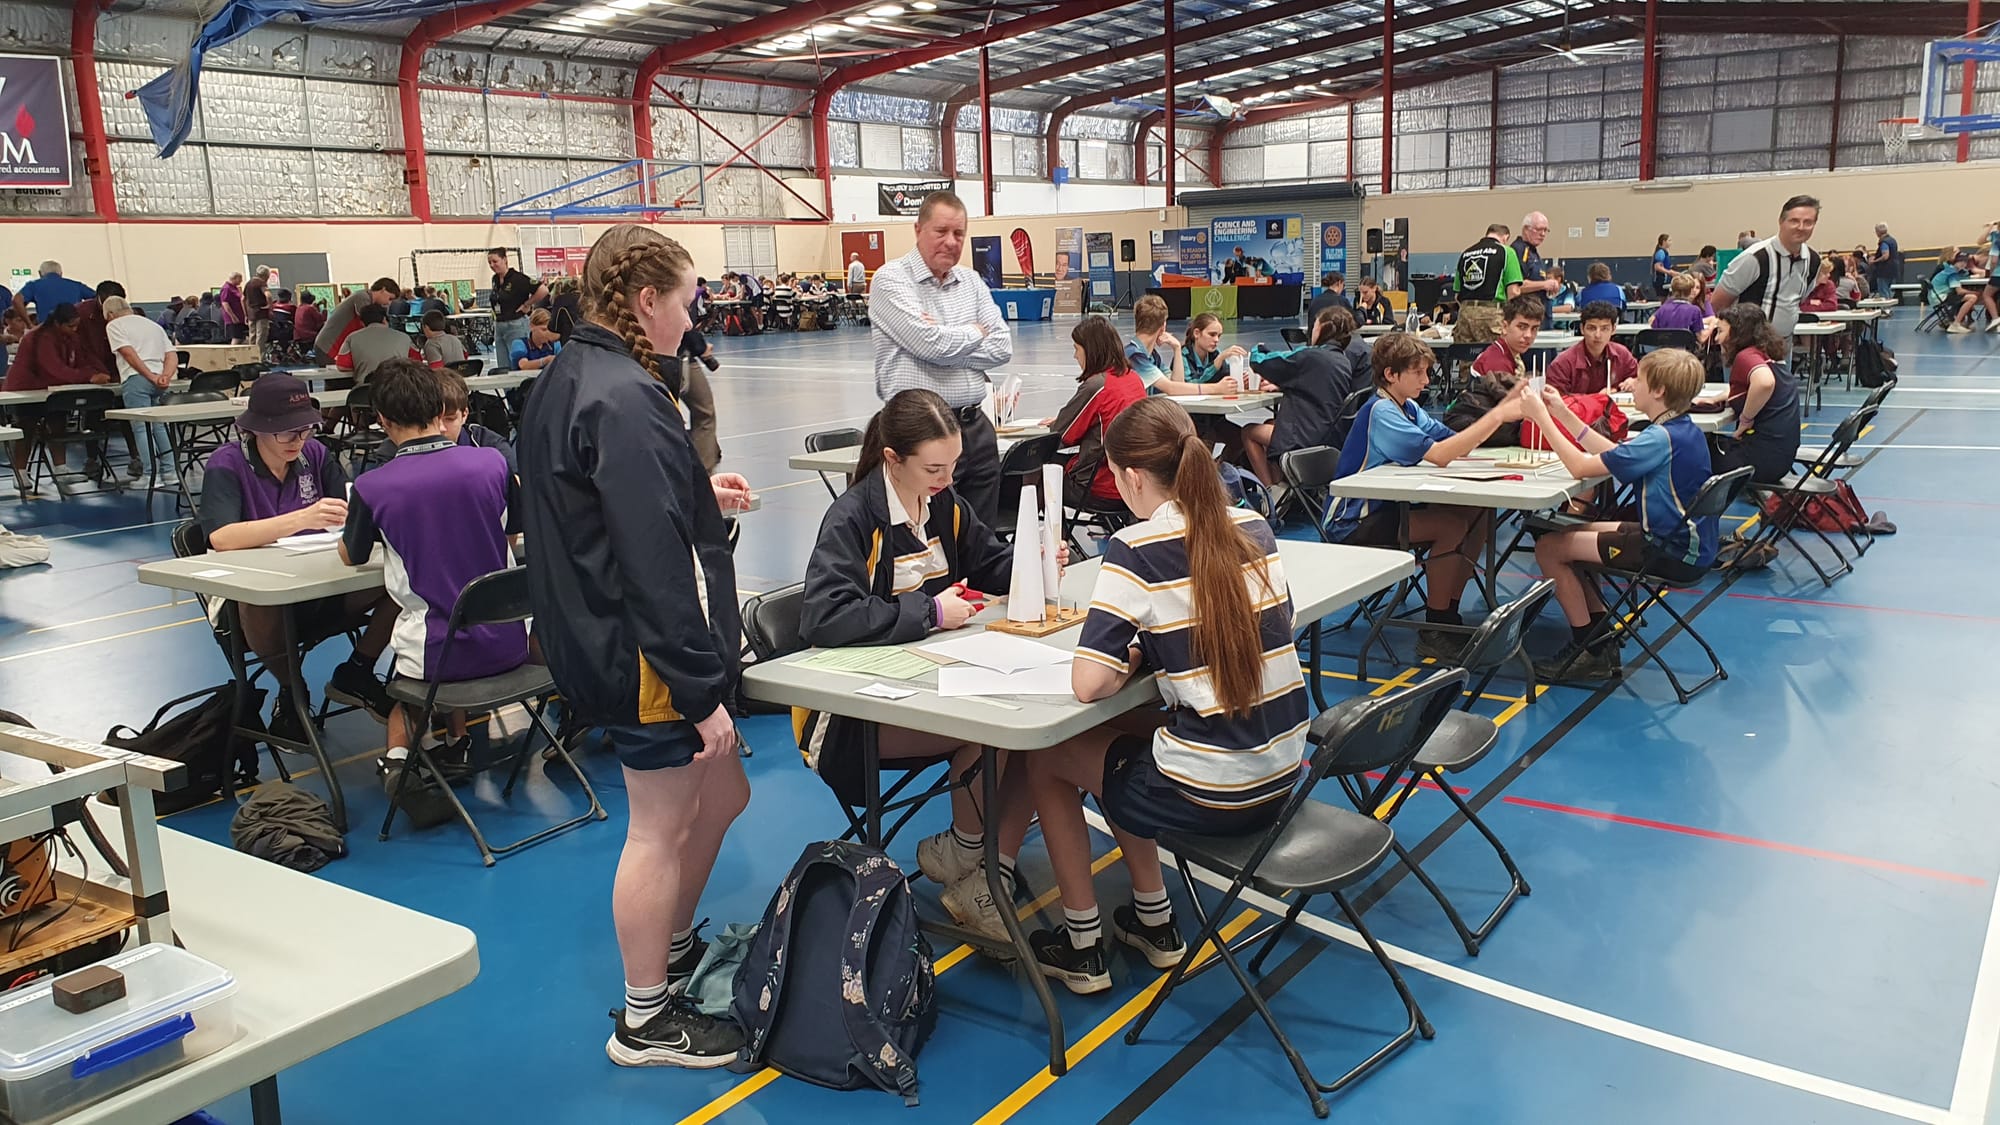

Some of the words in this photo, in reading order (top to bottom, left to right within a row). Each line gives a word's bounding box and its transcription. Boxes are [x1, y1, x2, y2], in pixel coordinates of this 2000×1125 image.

[14, 166, 61, 174] accountants
[908, 183, 942, 192] SUPPORTED
[942, 182, 951, 190] BY
[904, 196, 924, 207] Dom
[1214, 221, 1240, 230] SCIENCE
[1241, 220, 1256, 228] AND
[1214, 227, 1258, 235] ENGINEERING
[1214, 234, 1251, 242] CHALLENGE
